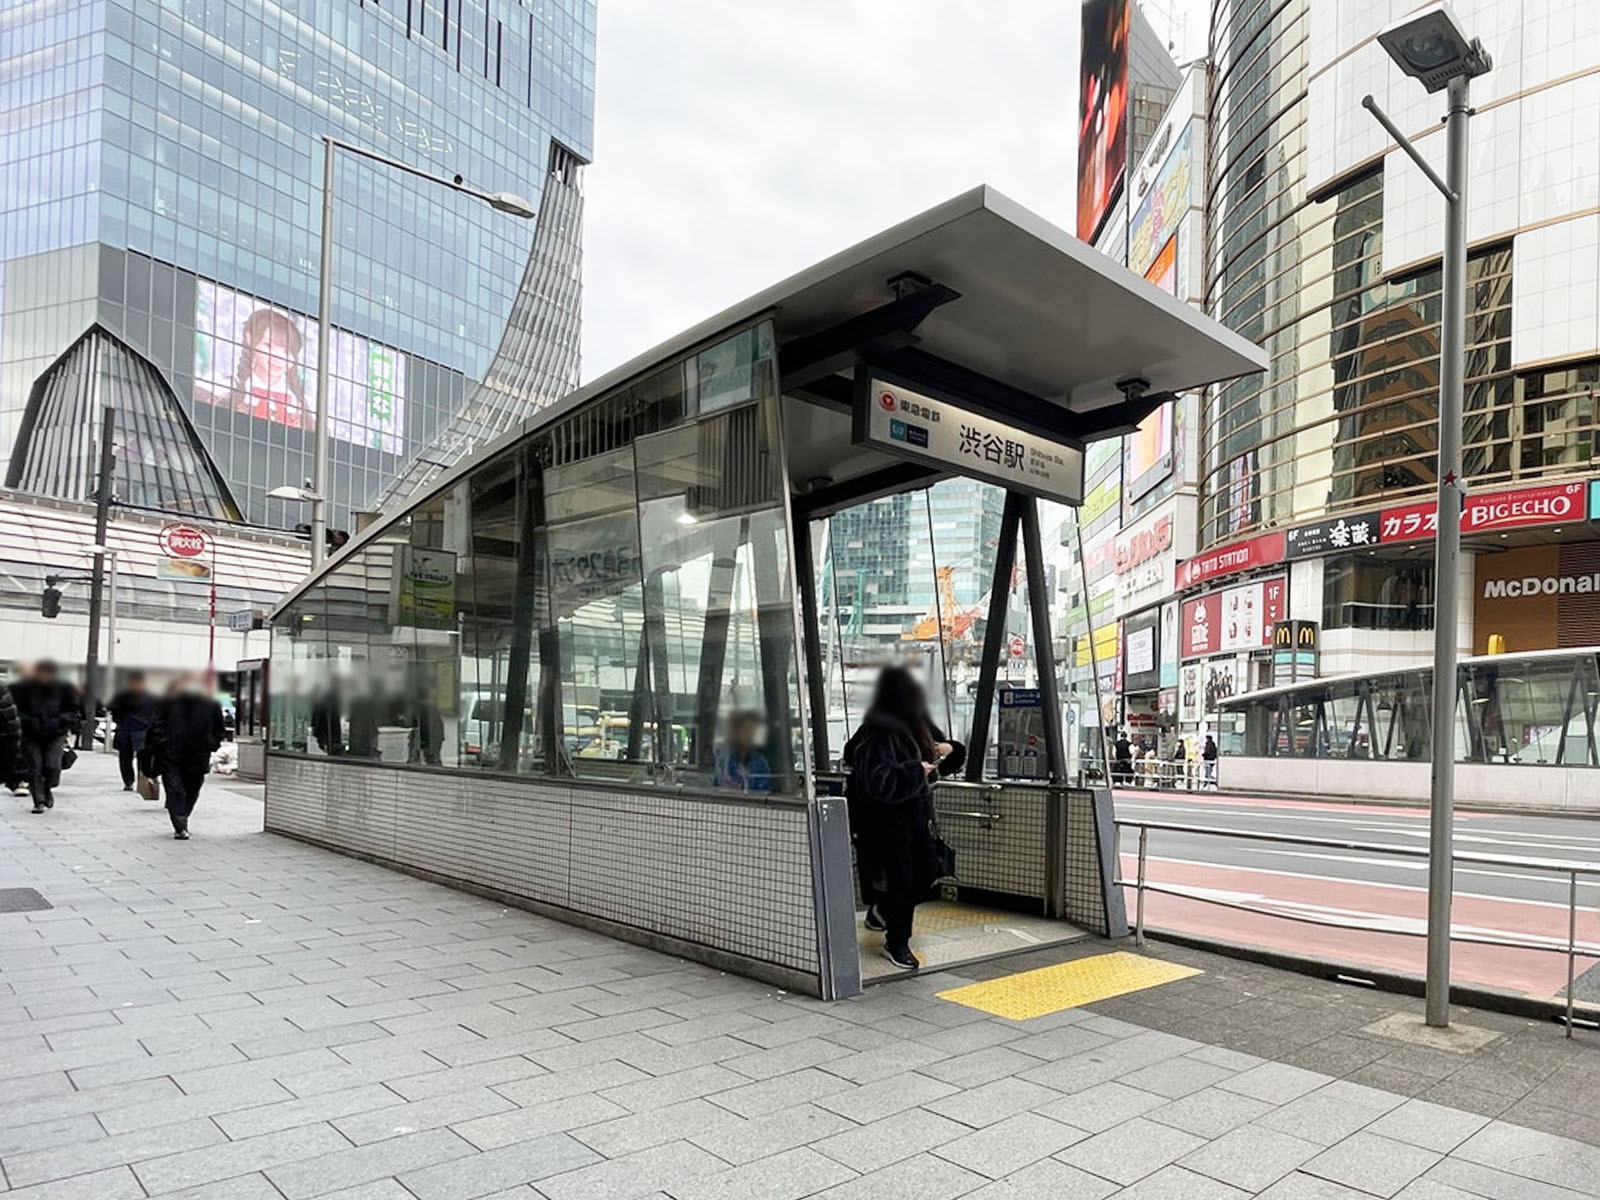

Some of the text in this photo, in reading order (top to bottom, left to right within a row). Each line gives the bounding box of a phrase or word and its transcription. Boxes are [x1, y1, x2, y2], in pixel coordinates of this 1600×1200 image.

[959, 424, 1025, 471] 渋谷駅
[1566, 484, 1582, 494] 6F
[1218, 548, 1249, 569] STATION
[1268, 586, 1280, 601] 1F
